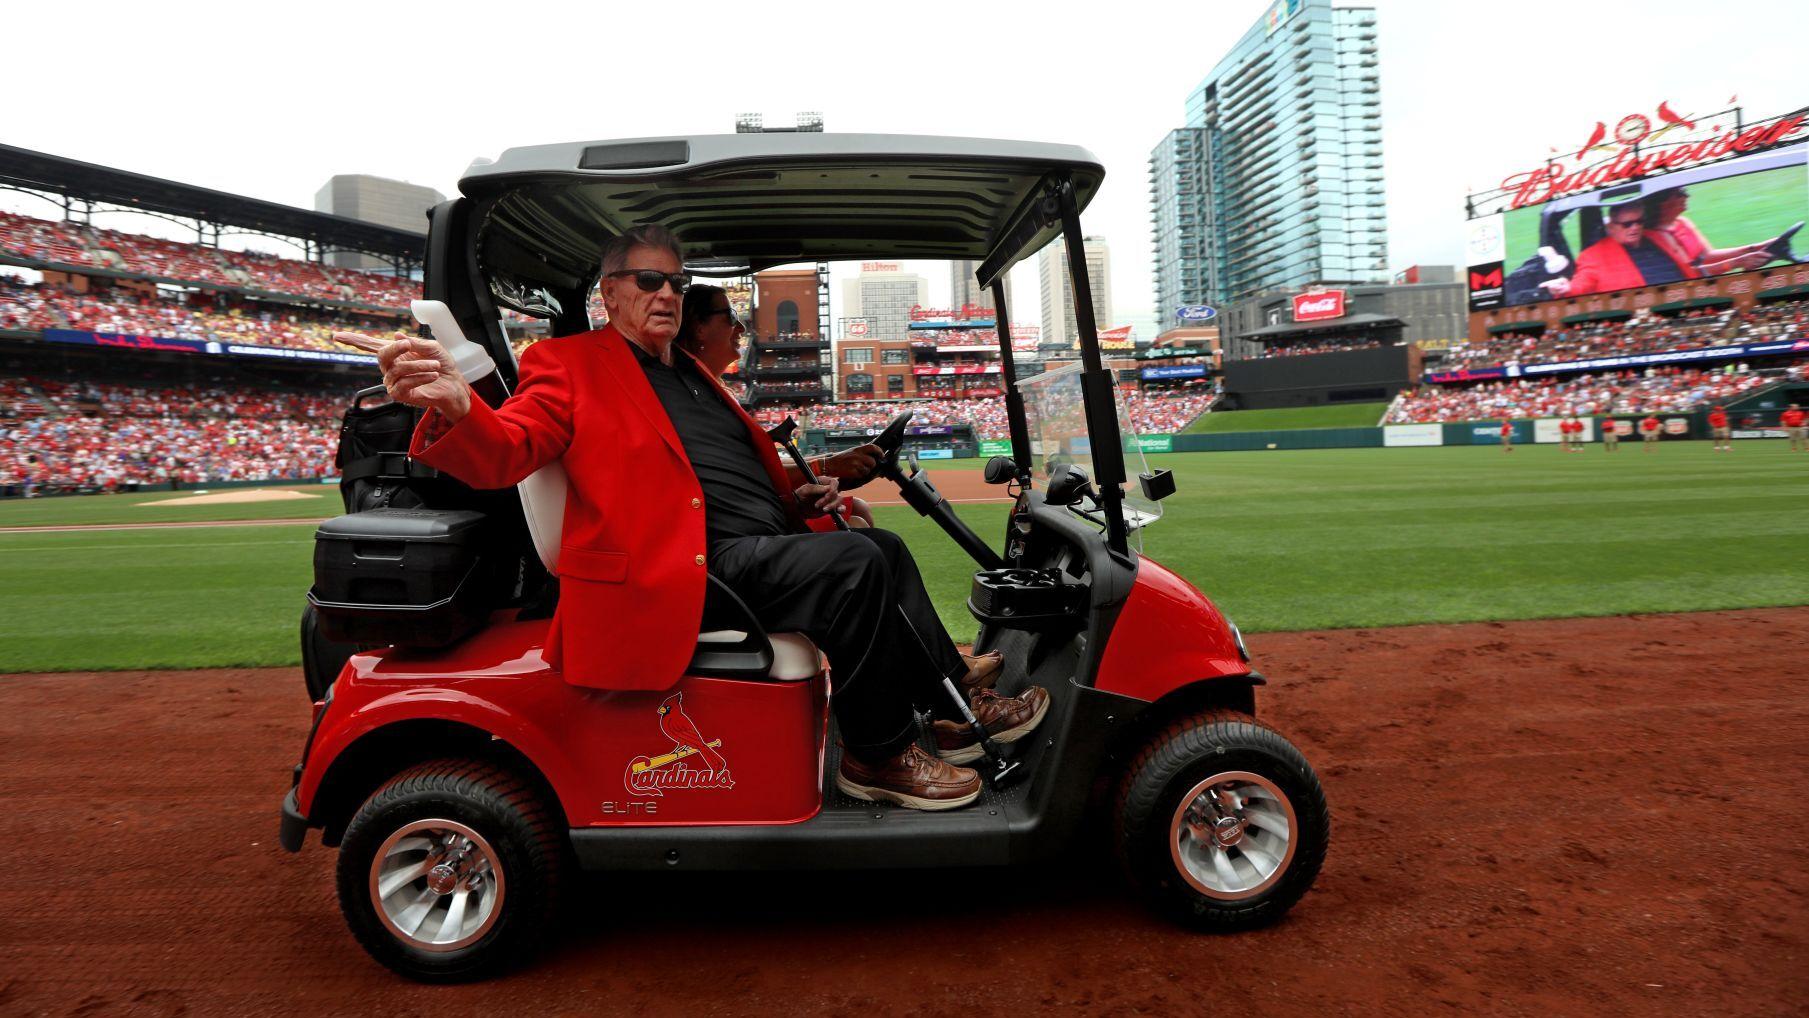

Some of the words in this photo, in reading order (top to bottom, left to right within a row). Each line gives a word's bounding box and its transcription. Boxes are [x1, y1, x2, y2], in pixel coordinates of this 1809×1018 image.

[1501, 115, 1807, 208] Budweiser
[862, 262, 898, 272] Hilton
[1183, 306, 1209, 318] Ford
[1298, 297, 1338, 315] Coca-Cola
[851, 325, 864, 333] 66
[624, 755, 736, 797] Cardinals
